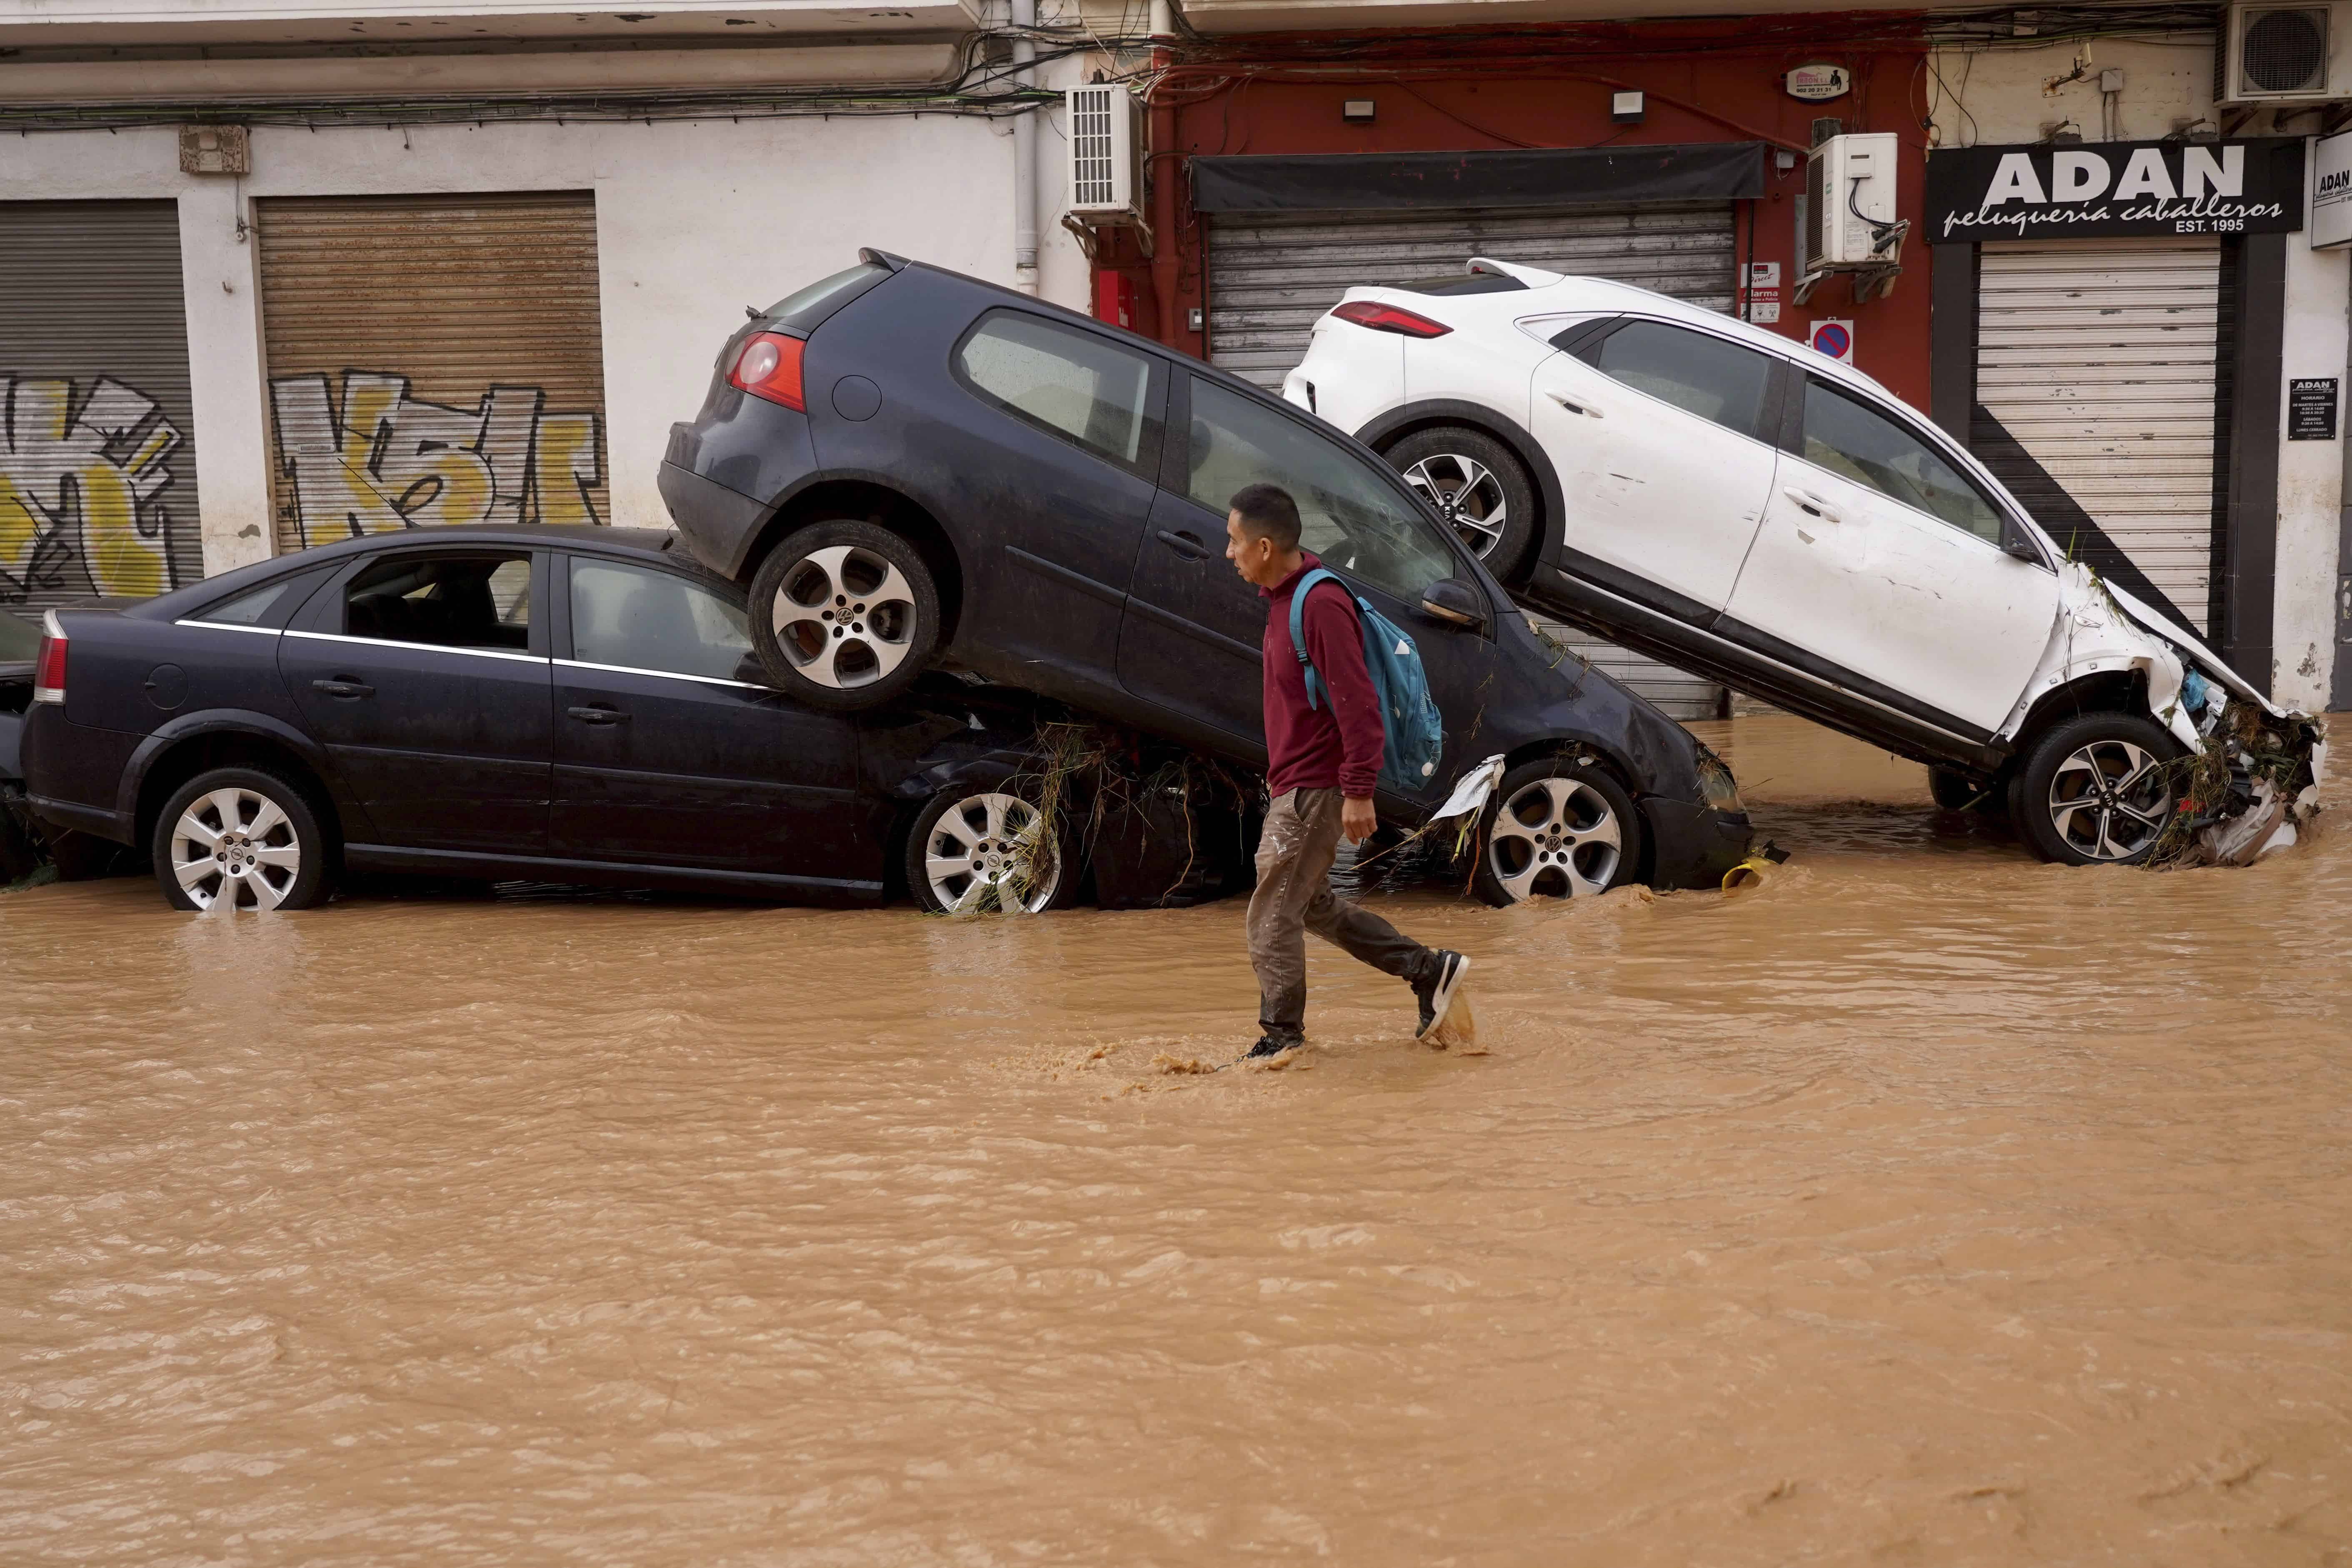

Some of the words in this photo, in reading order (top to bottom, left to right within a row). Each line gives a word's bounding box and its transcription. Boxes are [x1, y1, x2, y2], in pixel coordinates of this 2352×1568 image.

[1982, 146, 2244, 205] ADAN
[2319, 170, 2349, 194] ADAN
[1944, 202, 2110, 237] peluquería
[2120, 192, 2283, 221] caballeros
[2176, 220, 2206, 233] EST.
[2211, 219, 2244, 231] 1995
[2104, 793, 2114, 807] KIA
